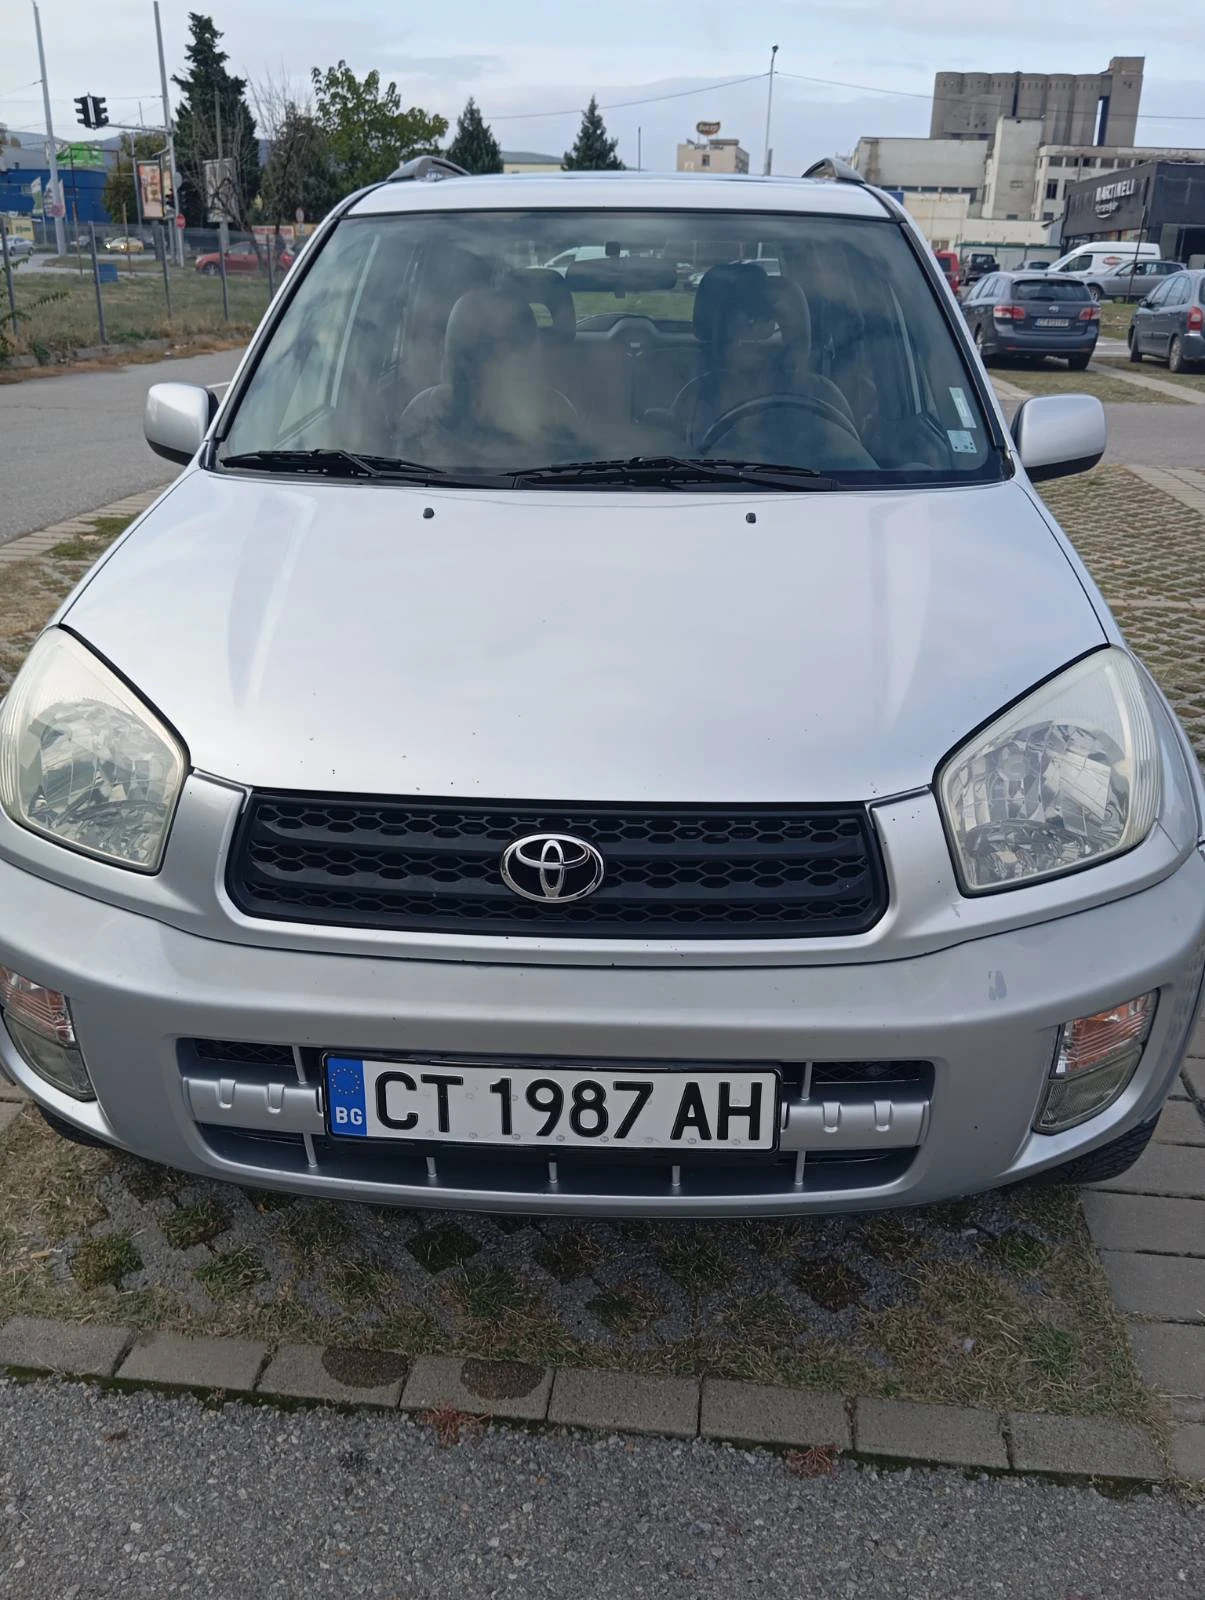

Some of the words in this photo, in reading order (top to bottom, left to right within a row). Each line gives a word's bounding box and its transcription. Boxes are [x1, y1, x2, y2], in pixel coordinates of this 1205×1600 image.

[335, 1106, 363, 1126] BG
[375, 1071, 463, 1133] CT
[489, 1077, 654, 1138] 1987
[670, 1081, 763, 1141] AH
